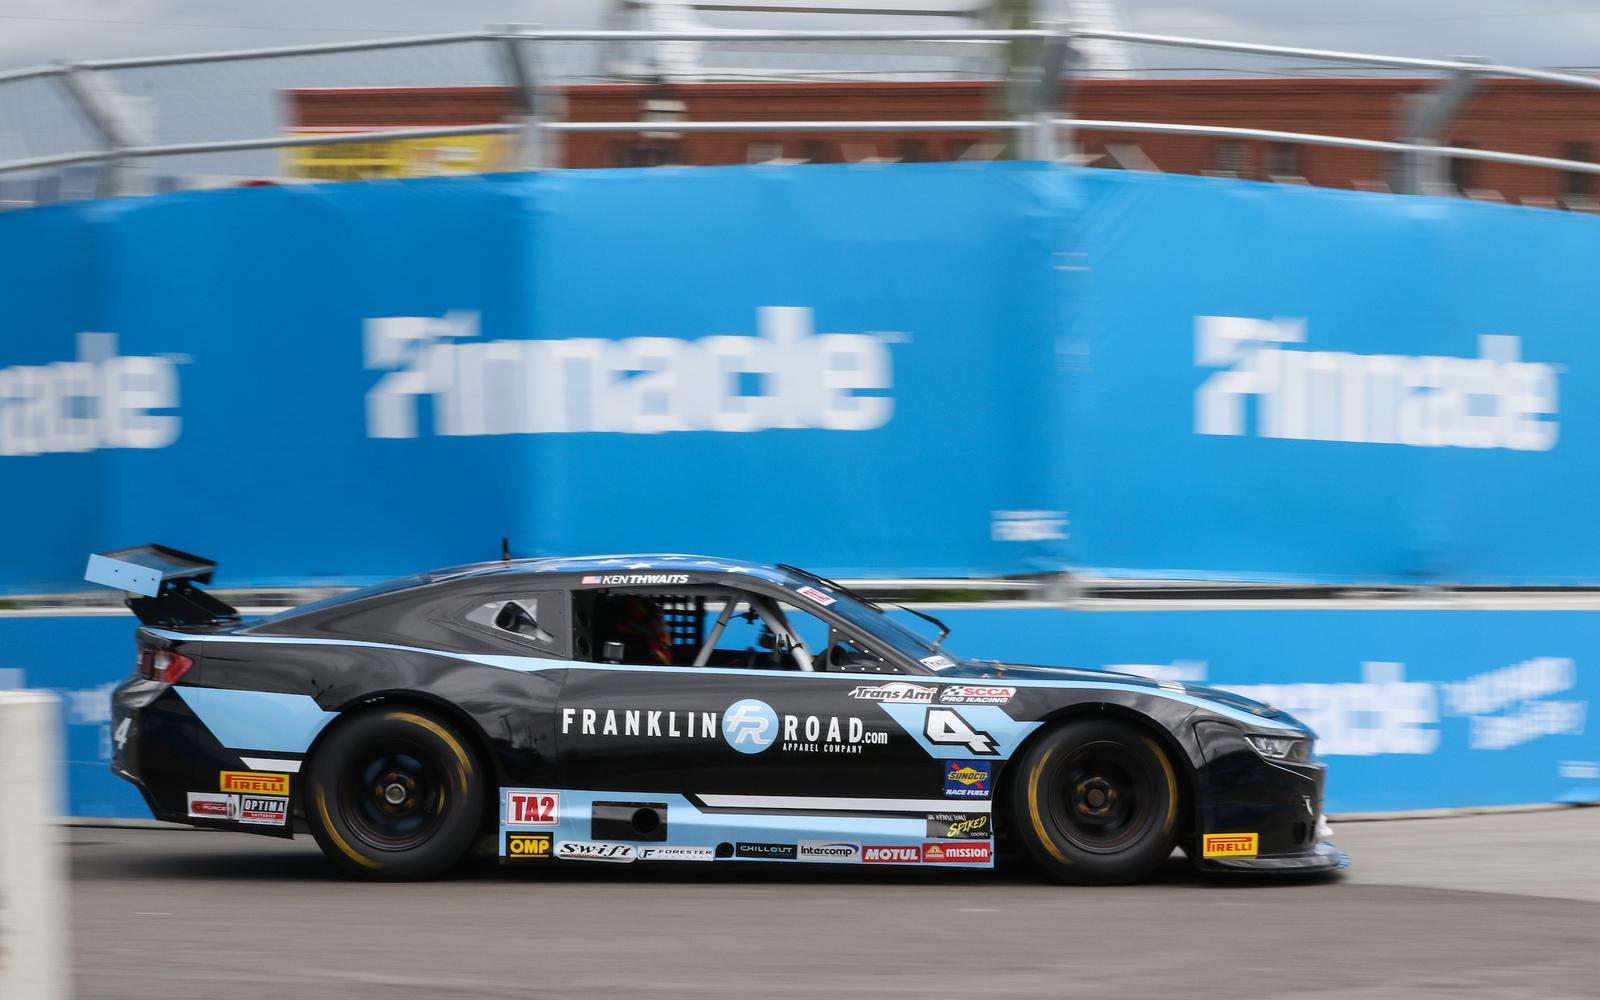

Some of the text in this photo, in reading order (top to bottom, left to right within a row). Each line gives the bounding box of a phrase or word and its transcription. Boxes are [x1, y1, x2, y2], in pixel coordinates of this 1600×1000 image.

[602, 574, 689, 584] KEN THWAITS
[856, 687, 931, 700] Trans Am
[964, 687, 1010, 697] SCCA
[562, 708, 717, 739] FRANKLIN
[114, 717, 132, 750] 4
[924, 707, 1001, 755] 4
[782, 742, 862, 754] APPAREL COMPANY
[949, 772, 986, 780] SUNOCO
[225, 774, 285, 792] PIRELLI
[245, 800, 285, 813] OPTIMA
[512, 796, 554, 822] TA2
[947, 816, 987, 838] SPIKED
[510, 839, 549, 854] OMP
[739, 845, 792, 853] CHILLOUT
[1207, 836, 1253, 852] PIRELLI
[801, 845, 853, 857] Intercomp
[864, 848, 919, 860] MOTUL
